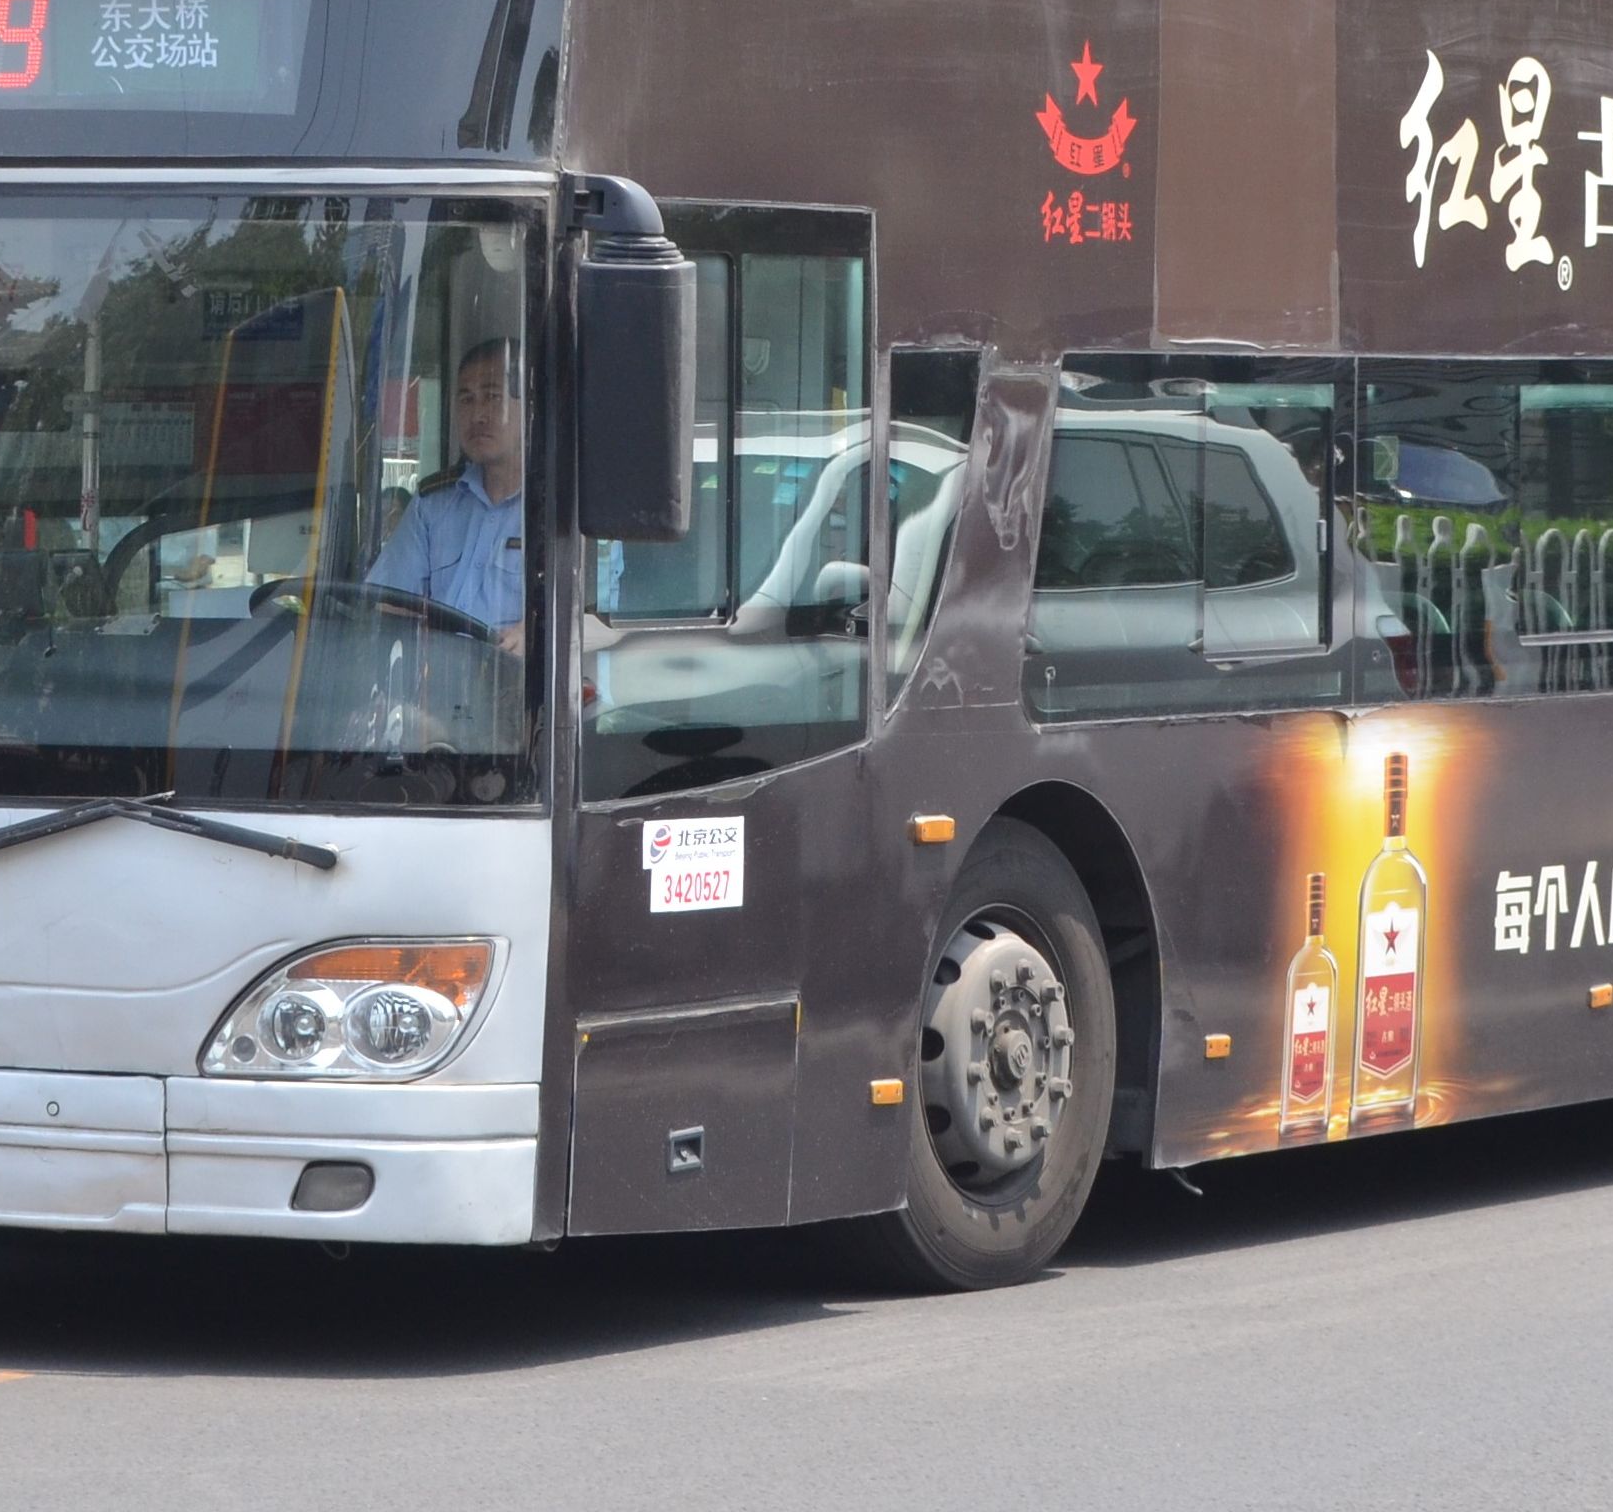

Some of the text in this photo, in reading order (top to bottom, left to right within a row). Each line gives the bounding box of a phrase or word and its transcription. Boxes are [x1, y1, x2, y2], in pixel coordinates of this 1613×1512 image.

[92, 31, 219, 69] 公交场站
[1041, 190, 1132, 244] 红星二锅头
[676, 827, 738, 847] 北京公交
[664, 870, 730, 904] 3420527
